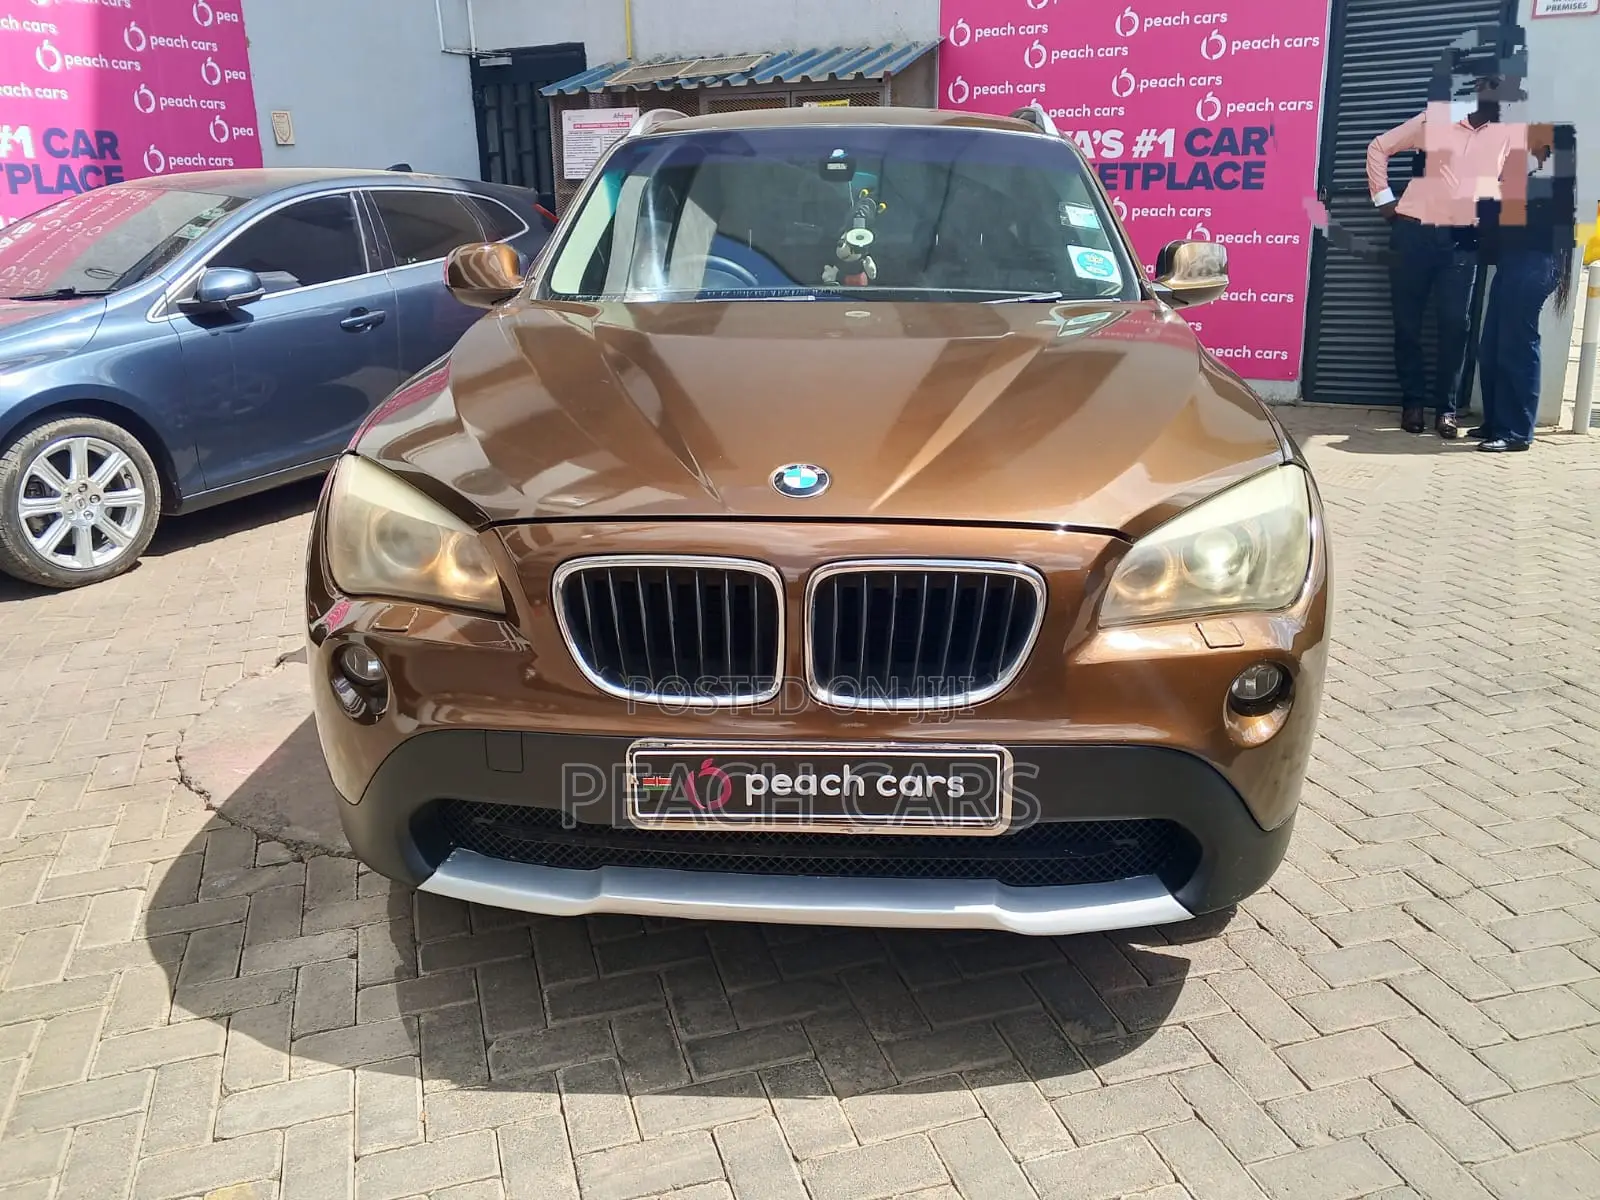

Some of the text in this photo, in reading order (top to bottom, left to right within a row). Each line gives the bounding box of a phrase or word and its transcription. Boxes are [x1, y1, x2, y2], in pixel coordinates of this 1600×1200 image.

[1545, 3, 1588, 12] PREMISES
[216, 11, 239, 24] pea
[1143, 11, 1228, 32] peach cars
[22, 20, 58, 34] cars
[975, 22, 1048, 42] peach cars
[149, 35, 218, 52] peach cars
[1231, 34, 1320, 55] peach cars
[64, 53, 142, 71] peach cars
[1051, 44, 1129, 64] peach cars
[224, 69, 247, 83] pea
[1140, 73, 1222, 93] peach cars
[34, 87, 69, 100] cars
[973, 81, 1046, 99] peach cars
[159, 94, 227, 110] peach cars
[1094, 105, 1125, 116] cars
[1226, 97, 1314, 117] peach cars
[232, 127, 254, 140] pea
[42, 128, 121, 160] CAR
[1067, 126, 1269, 159] A'S #1 CAR
[169, 153, 234, 170] peach cars
[0, 163, 124, 195] PLACE
[1093, 160, 1266, 191] ETPLACE
[1131, 204, 1212, 221] peach cars
[1266, 232, 1300, 244] cars
[1212, 288, 1294, 304] each cars
[1254, 349, 1288, 360] cars
[745, 764, 965, 806] peach cars
